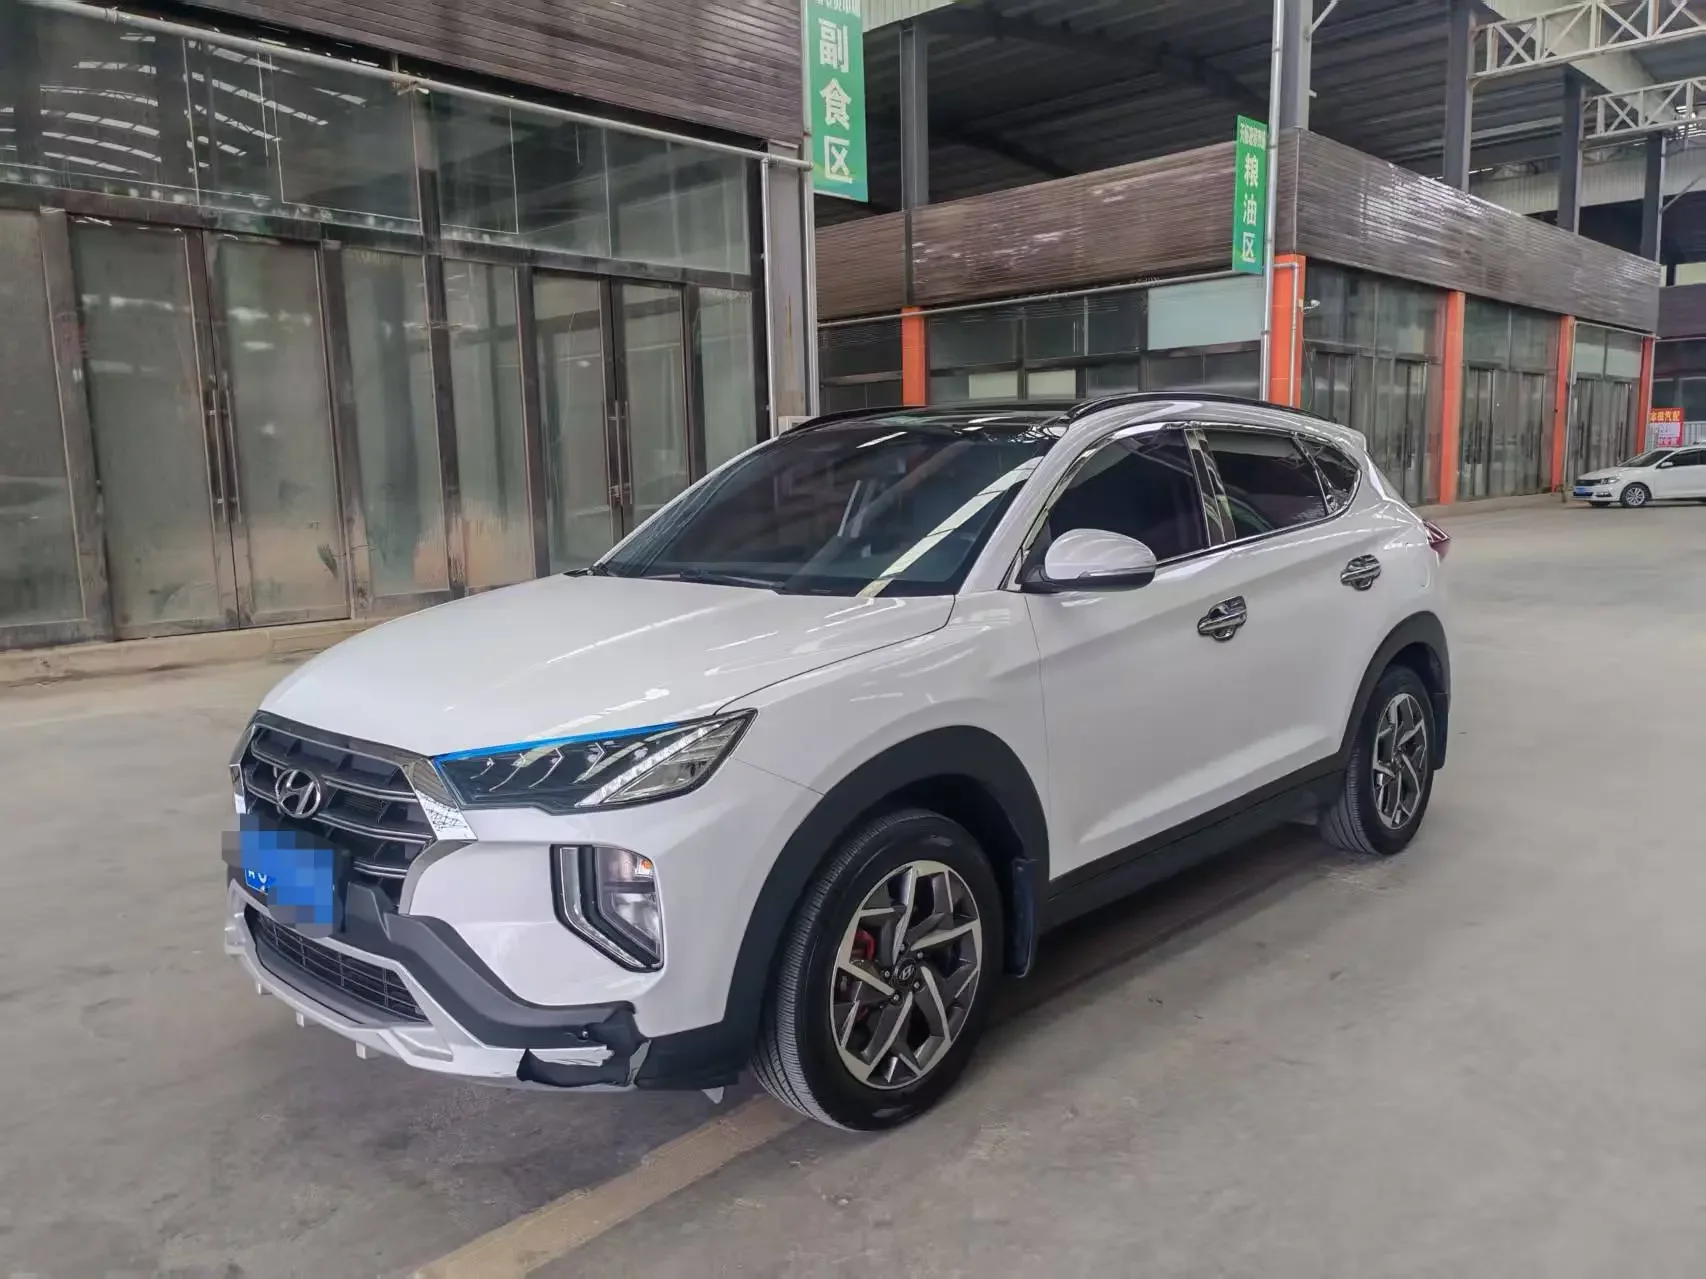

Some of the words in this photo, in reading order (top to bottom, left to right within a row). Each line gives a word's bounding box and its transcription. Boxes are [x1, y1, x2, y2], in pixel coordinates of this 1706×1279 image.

[818, 18, 852, 184] 副食区
[1242, 153, 1259, 263] 粮油区
